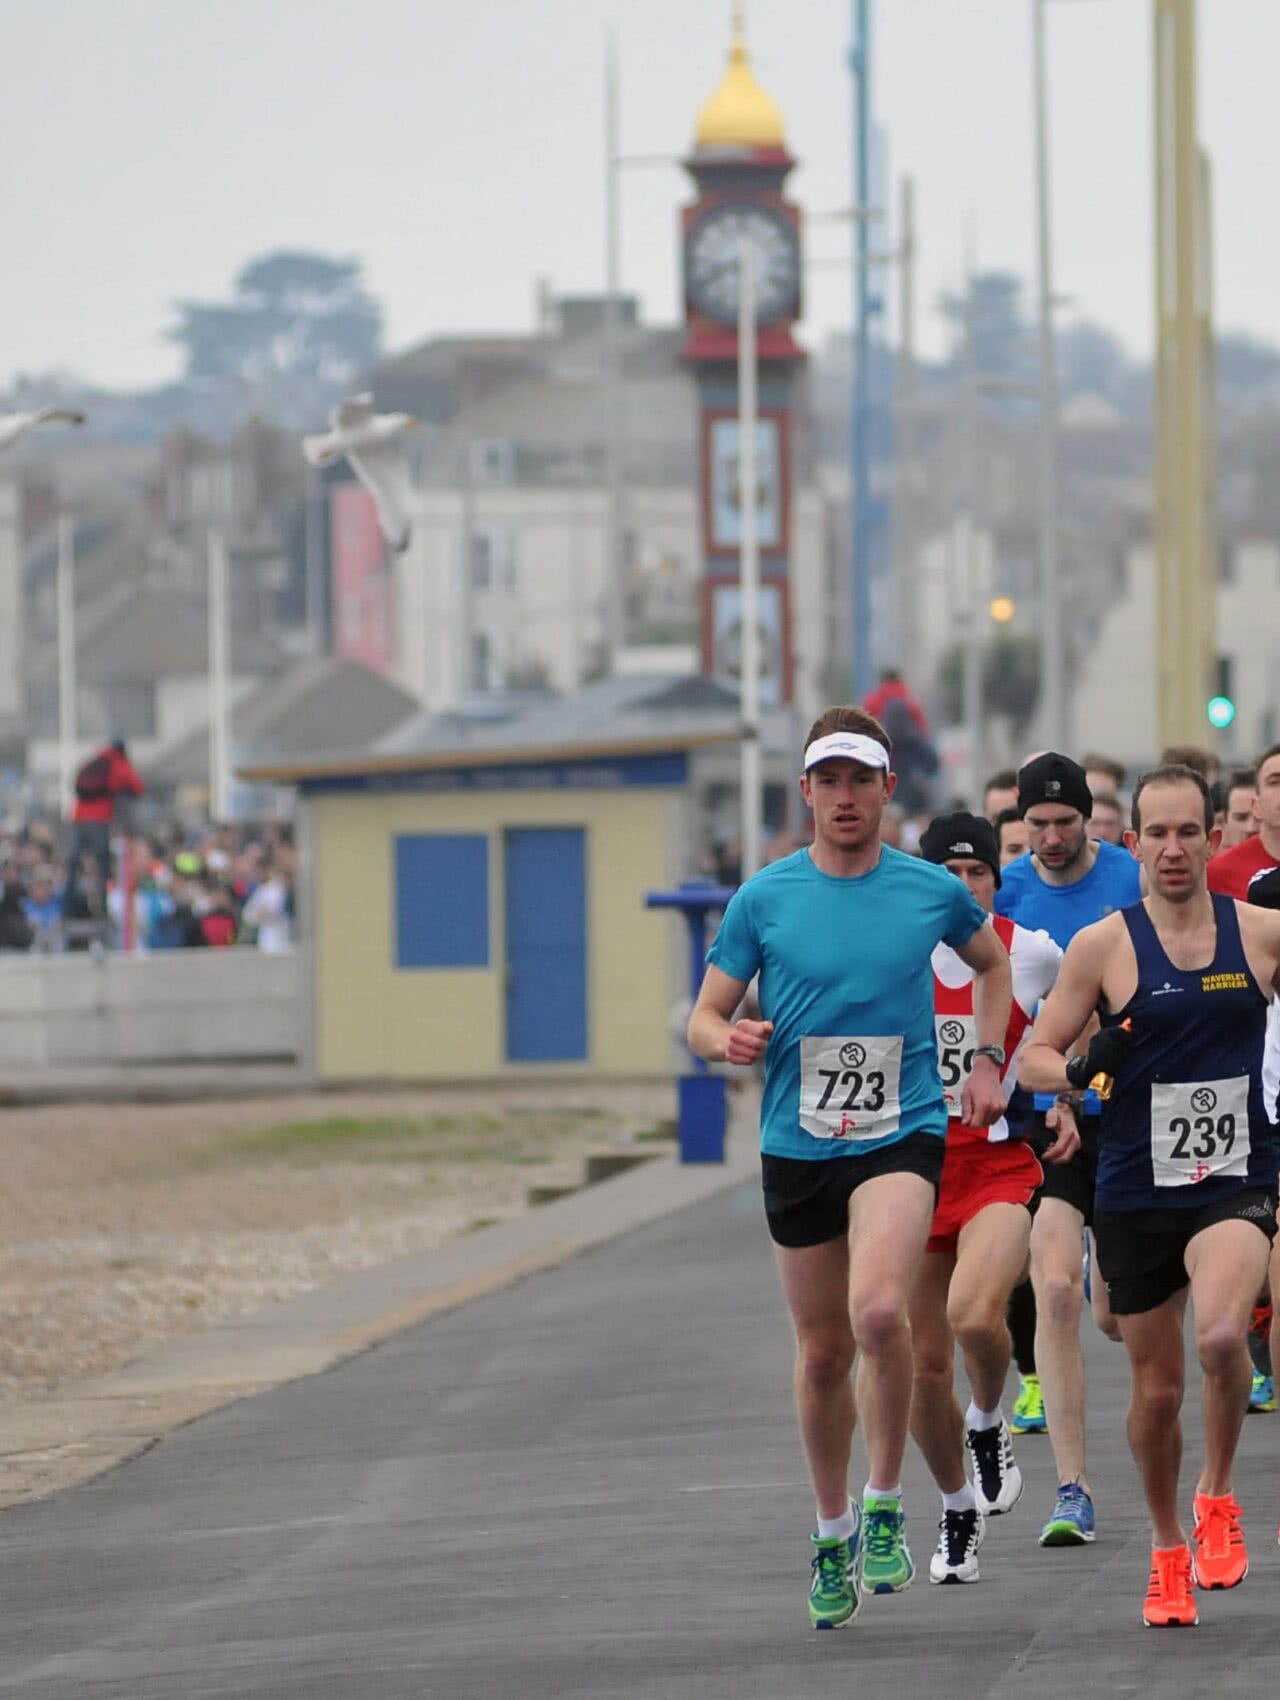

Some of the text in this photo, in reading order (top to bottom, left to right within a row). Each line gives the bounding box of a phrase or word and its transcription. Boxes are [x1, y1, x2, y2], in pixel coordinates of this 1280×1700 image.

[1201, 972, 1246, 984] WAVERLEY
[1202, 980, 1249, 992] HARRIERS
[816, 1069, 885, 1112] 723
[1169, 1113, 1236, 1159] 239
